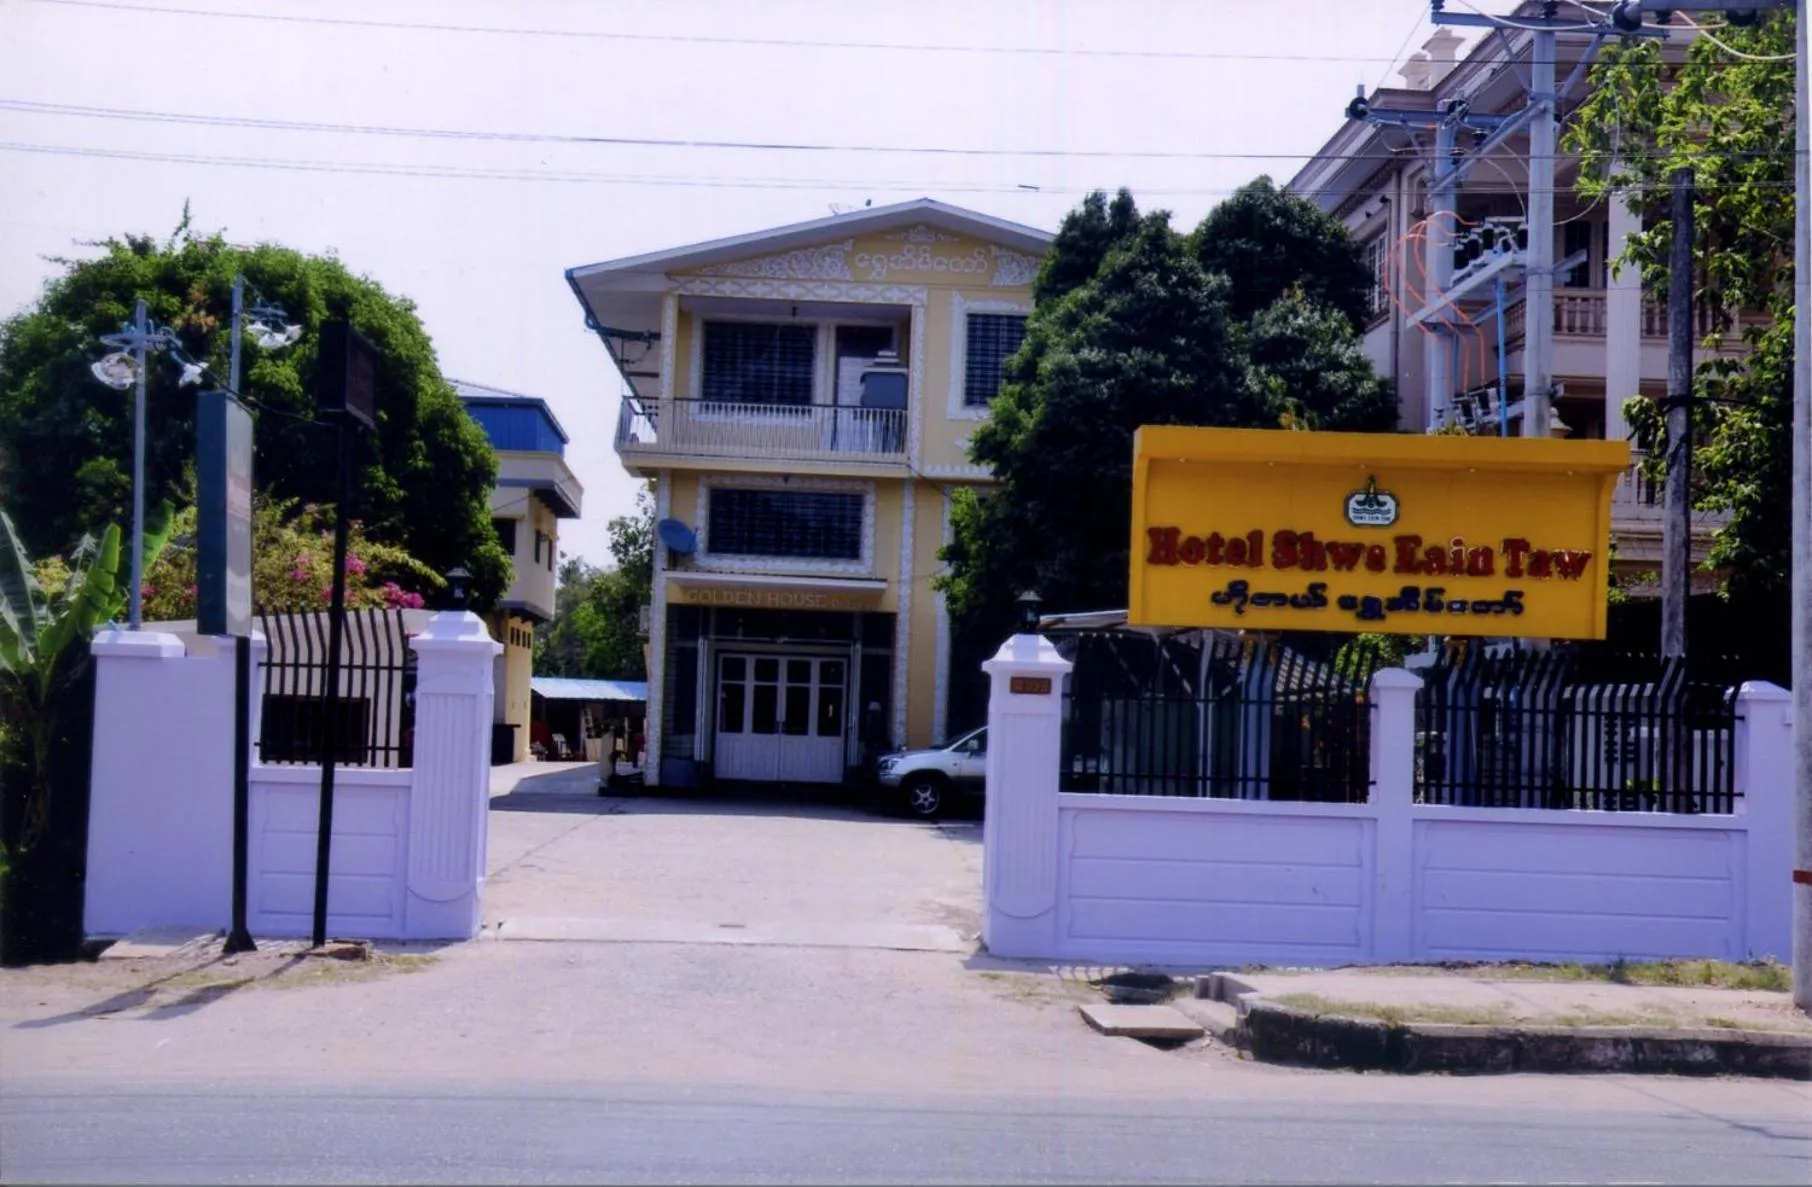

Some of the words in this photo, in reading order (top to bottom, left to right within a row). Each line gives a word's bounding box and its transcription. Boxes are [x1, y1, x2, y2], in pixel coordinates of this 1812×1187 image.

[1146, 526, 1264, 568] Hotel
[1271, 529, 1387, 573] Shwe
[1394, 535, 1494, 577] Eain
[1503, 538, 1592, 580] Taw
[686, 588, 761, 606] GOLDEN
[768, 592, 828, 608] HOUSE
